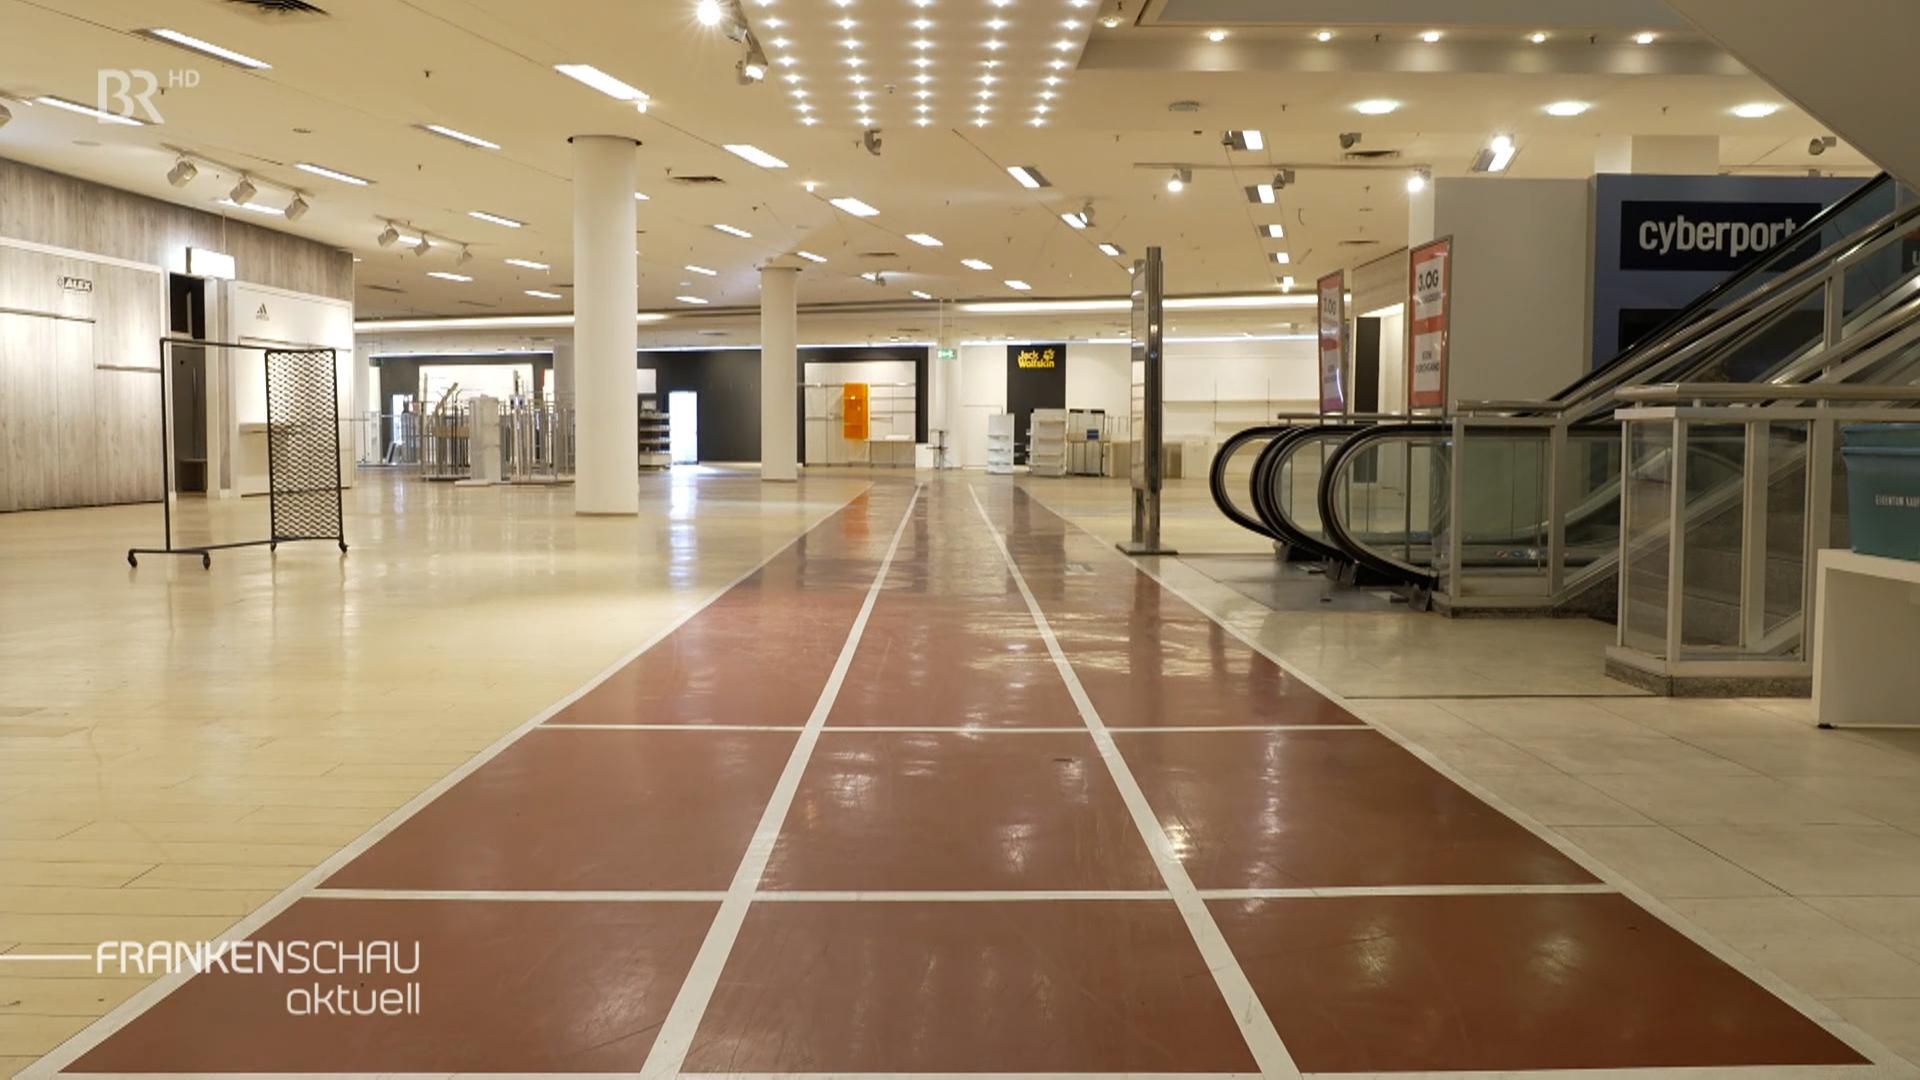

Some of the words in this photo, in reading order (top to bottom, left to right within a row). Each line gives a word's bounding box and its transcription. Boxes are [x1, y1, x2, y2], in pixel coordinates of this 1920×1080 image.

[1639, 215, 1796, 257] cyberport
[64, 278, 91, 291] ALEX
[1417, 269, 1439, 291] 3.OG
[1018, 350, 1039, 360] Jack
[1018, 358, 1055, 368] Wolfskin
